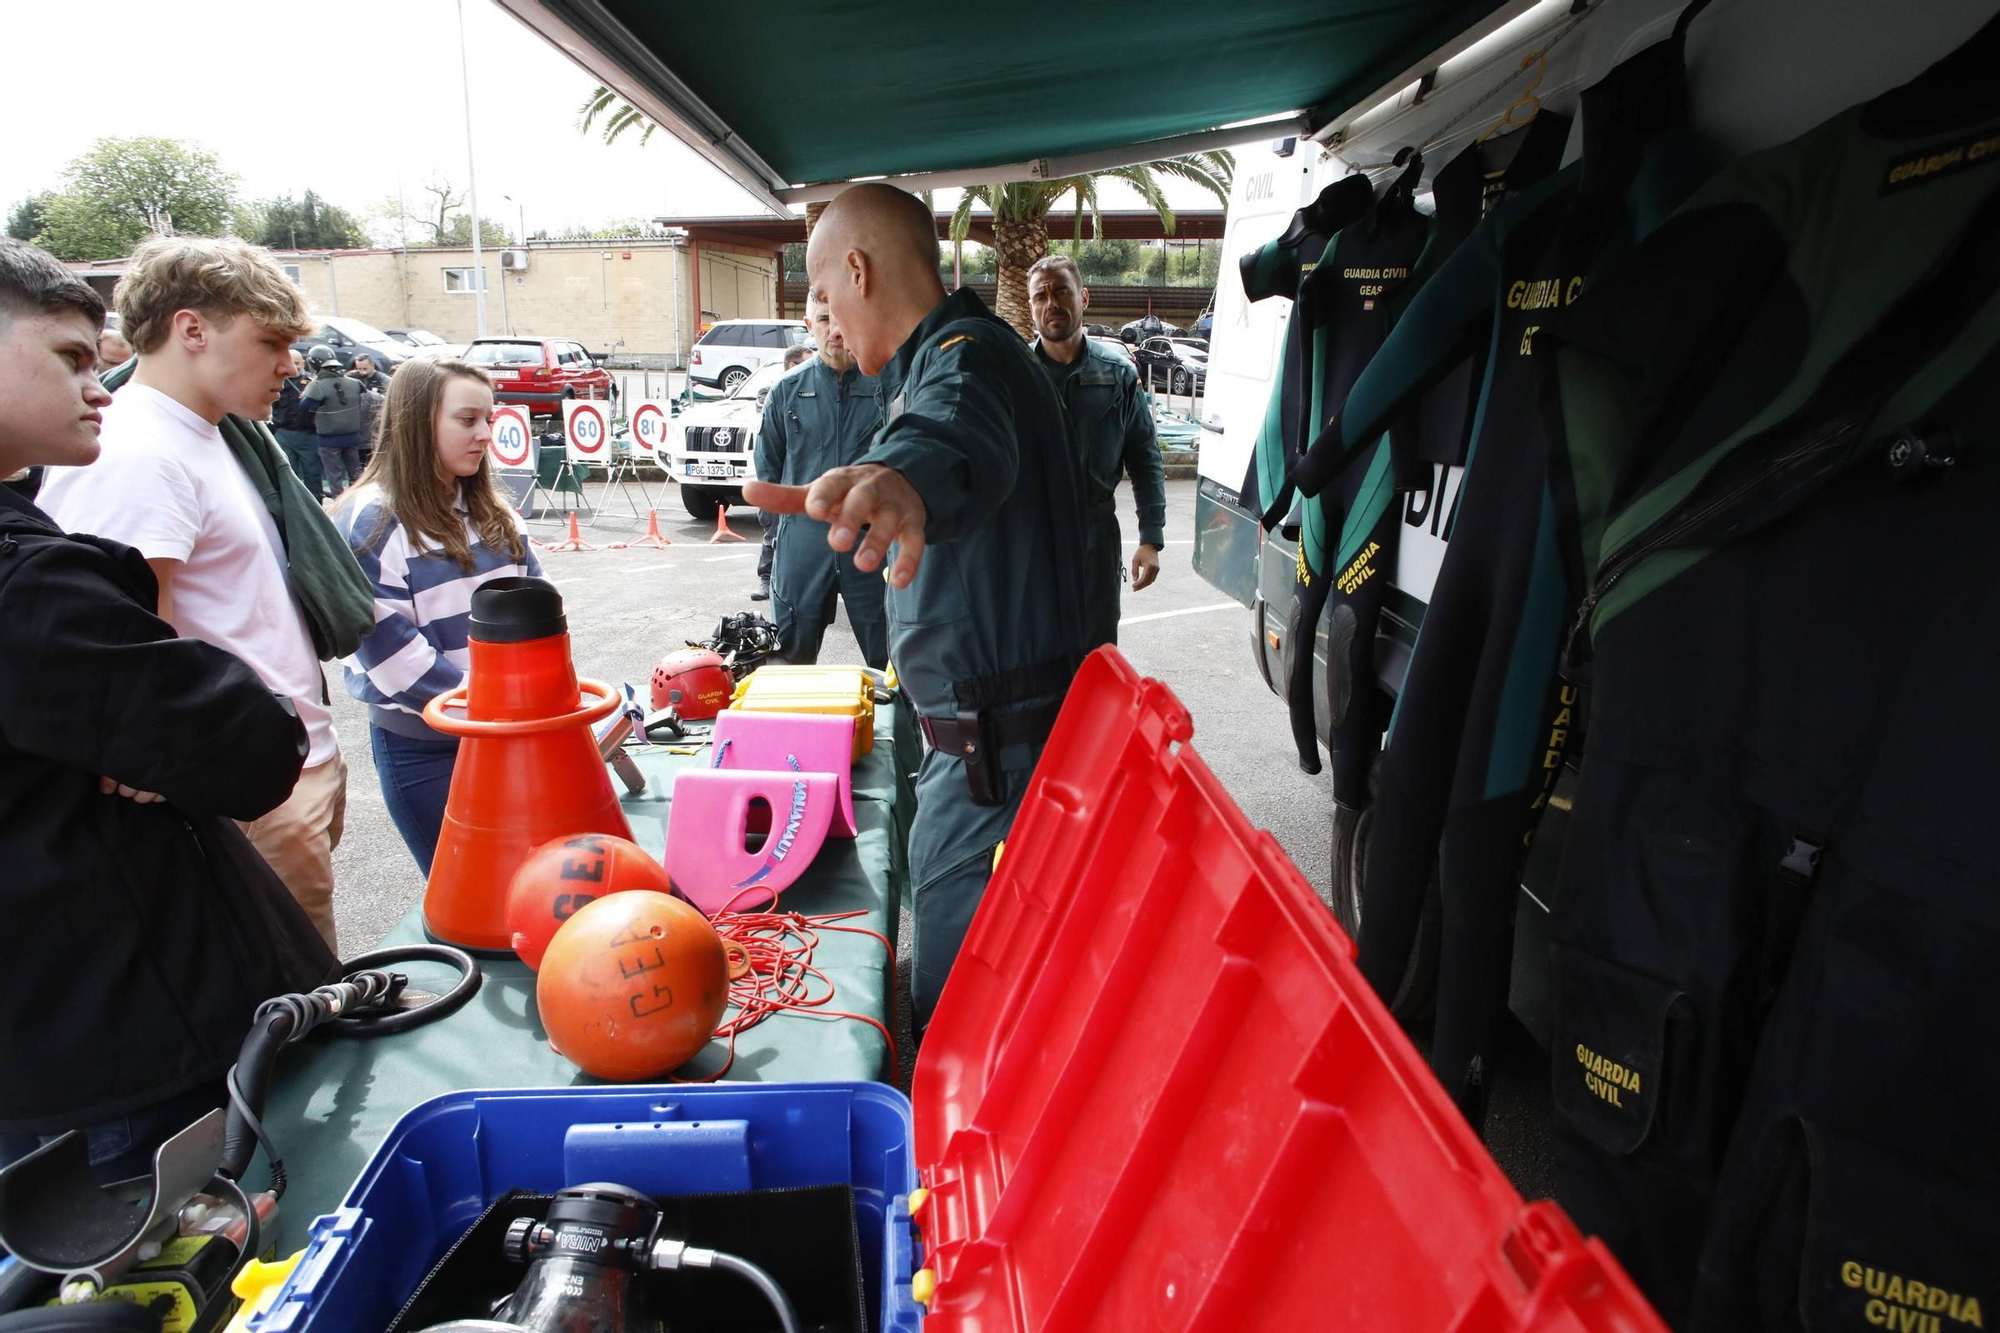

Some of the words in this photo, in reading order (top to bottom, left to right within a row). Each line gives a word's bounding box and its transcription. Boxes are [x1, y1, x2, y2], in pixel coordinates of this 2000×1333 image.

[1246, 172, 1274, 202] CIVIL
[1343, 268, 1380, 279] GUARDIA
[498, 426, 521, 449] 40
[577, 420, 597, 439] 60
[691, 465, 705, 475] PGC
[707, 466, 725, 475] 1375
[1337, 541, 1380, 590] GUARDIA
[1345, 565, 1376, 595] CIVIL
[771, 779, 808, 862] AQUANAUT
[1576, 1043, 1641, 1095] GUARDIA
[1585, 1071, 1624, 1109] CIVIL
[561, 1233, 601, 1253] NIRA
[1841, 1260, 1984, 1329] GUARDIA
